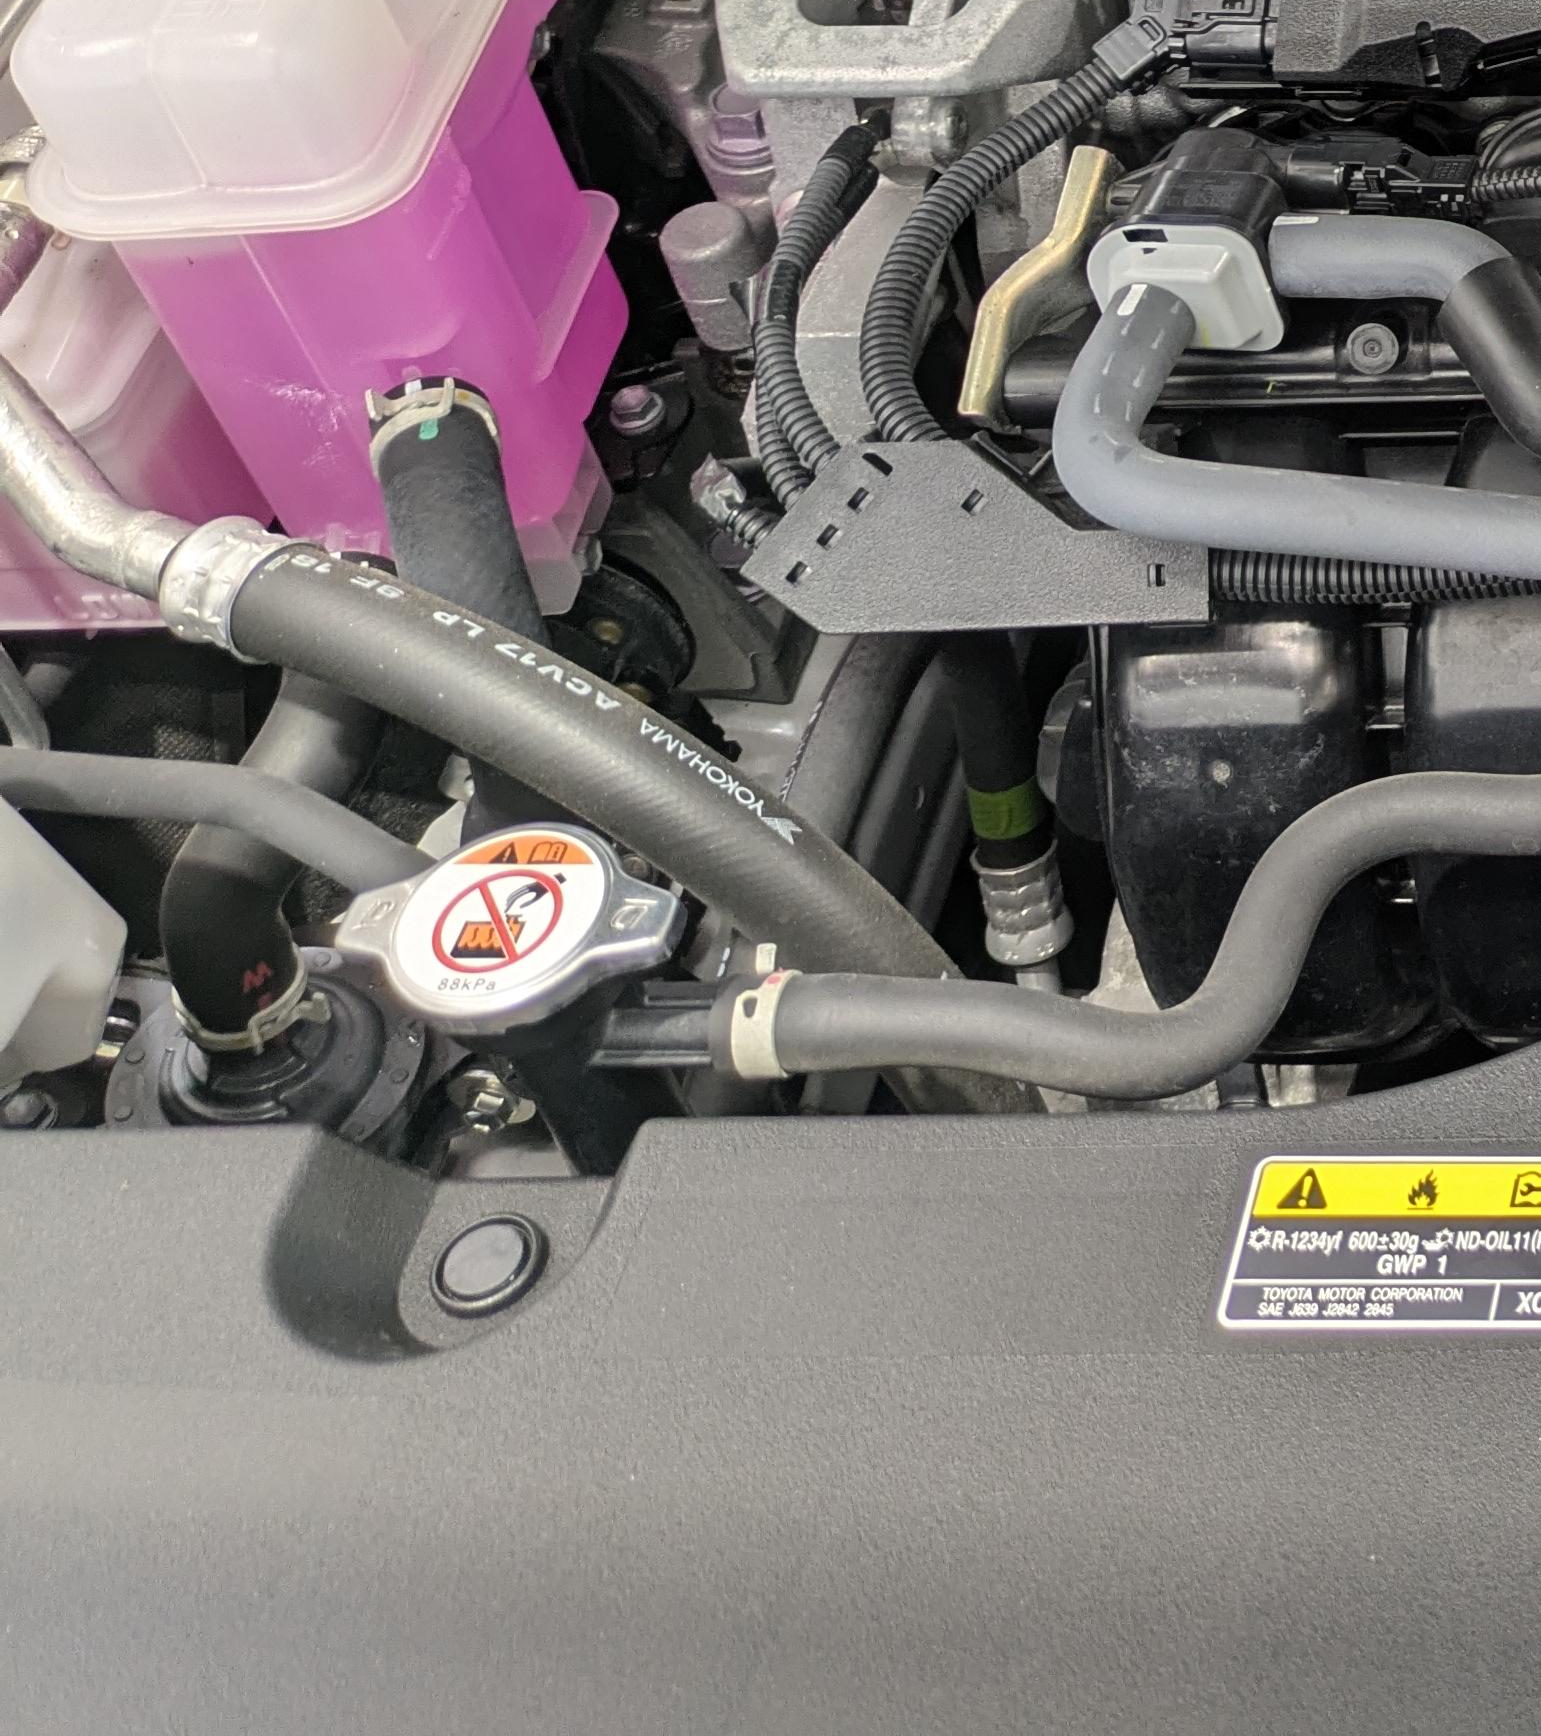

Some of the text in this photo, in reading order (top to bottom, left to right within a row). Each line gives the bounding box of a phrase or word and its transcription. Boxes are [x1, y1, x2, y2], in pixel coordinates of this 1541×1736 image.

[432, 609, 487, 642] LP
[495, 641, 623, 712] ACV17
[639, 717, 766, 818] YOKOHAMA
[438, 977, 497, 992] 88kPa
[1272, 1229, 1344, 1255] R-1234yf
[1348, 1230, 1420, 1255] 600±30g
[1377, 1254, 1448, 1275] GWP 1
[1262, 1287, 1464, 1302] TOYOTA MOTOR CORPORATION
[1257, 1302, 1284, 1317] SAE
[1288, 1302, 1319, 1317] J639
[1322, 1302, 1360, 1317] J2842
